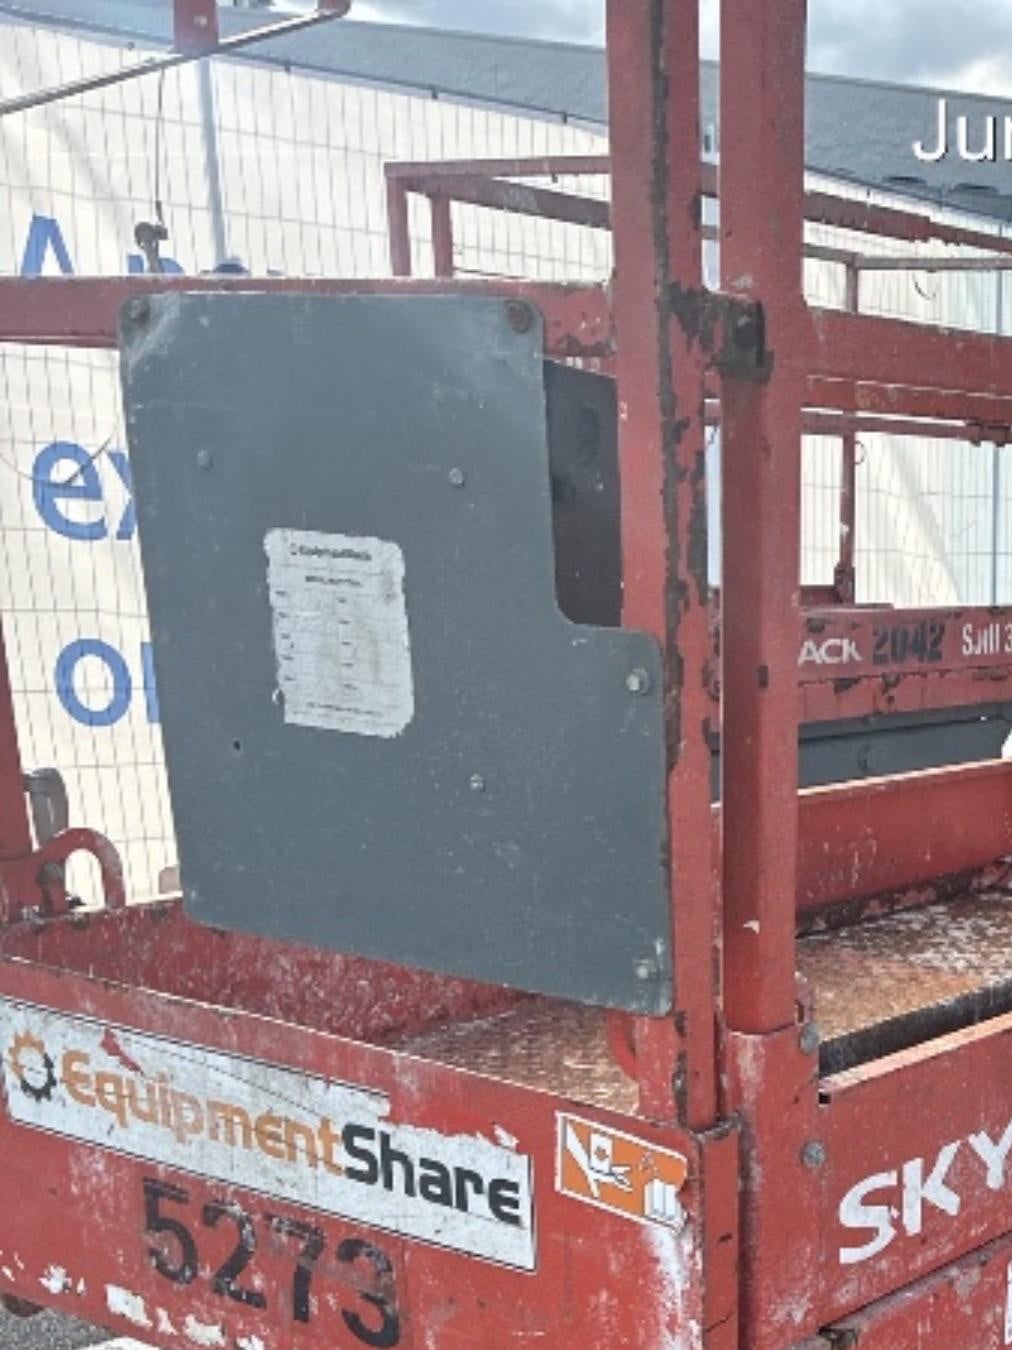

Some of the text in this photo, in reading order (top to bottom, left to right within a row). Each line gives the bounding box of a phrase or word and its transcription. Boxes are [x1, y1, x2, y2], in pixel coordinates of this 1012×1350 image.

[872, 623, 945, 667] 2042
[60, 1050, 521, 1226] EquipmentShare
[142, 1177, 403, 1349] 5273
